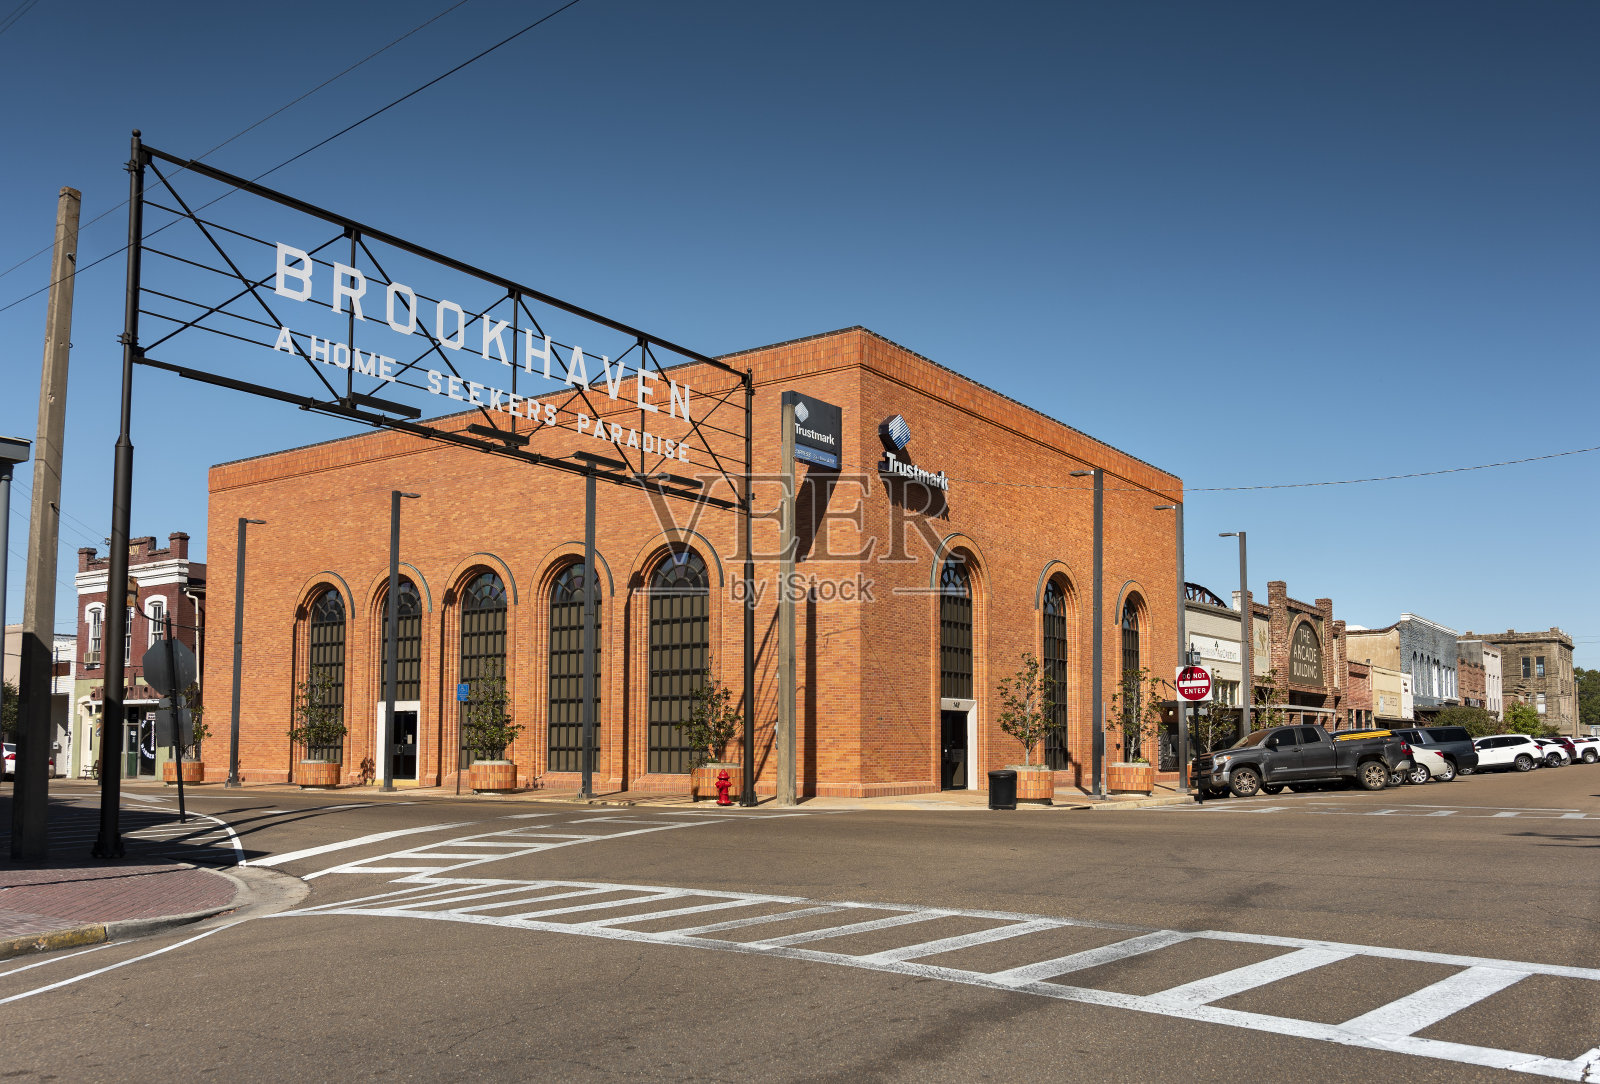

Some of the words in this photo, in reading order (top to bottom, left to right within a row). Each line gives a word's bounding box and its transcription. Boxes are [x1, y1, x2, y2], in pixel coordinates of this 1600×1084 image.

[274, 242, 690, 424] BROOKHAVEN
[274, 327, 297, 356] A
[309, 335, 397, 383] HOME
[427, 369, 557, 427] SEEKERS
[577, 412, 690, 464] PARADISE
[795, 423, 835, 445] Trustmark
[886, 451, 949, 491] Trustmark
[1300, 628, 1310, 644] THE
[1293, 644, 1317, 663] ARCADE
[1293, 661, 1318, 680] BUILDING
[1184, 687, 1206, 695] ENTER
